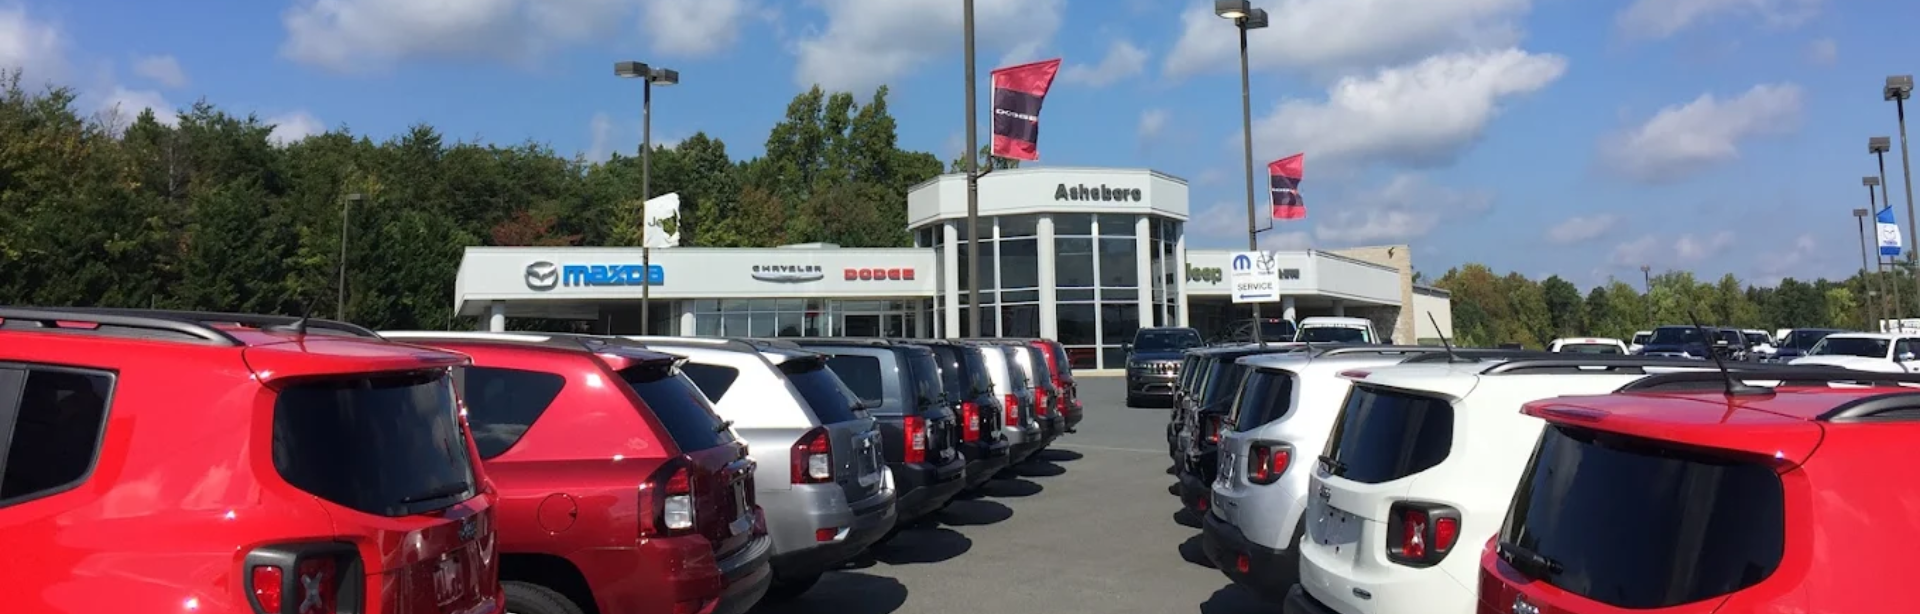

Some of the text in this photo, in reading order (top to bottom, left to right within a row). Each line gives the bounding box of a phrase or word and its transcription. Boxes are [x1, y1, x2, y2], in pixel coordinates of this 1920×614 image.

[1054, 183, 1142, 202] Asheboro
[752, 265, 823, 273] CHRYSLER
[844, 268, 915, 281] DODGE
[1237, 282, 1273, 291] SERVICE
